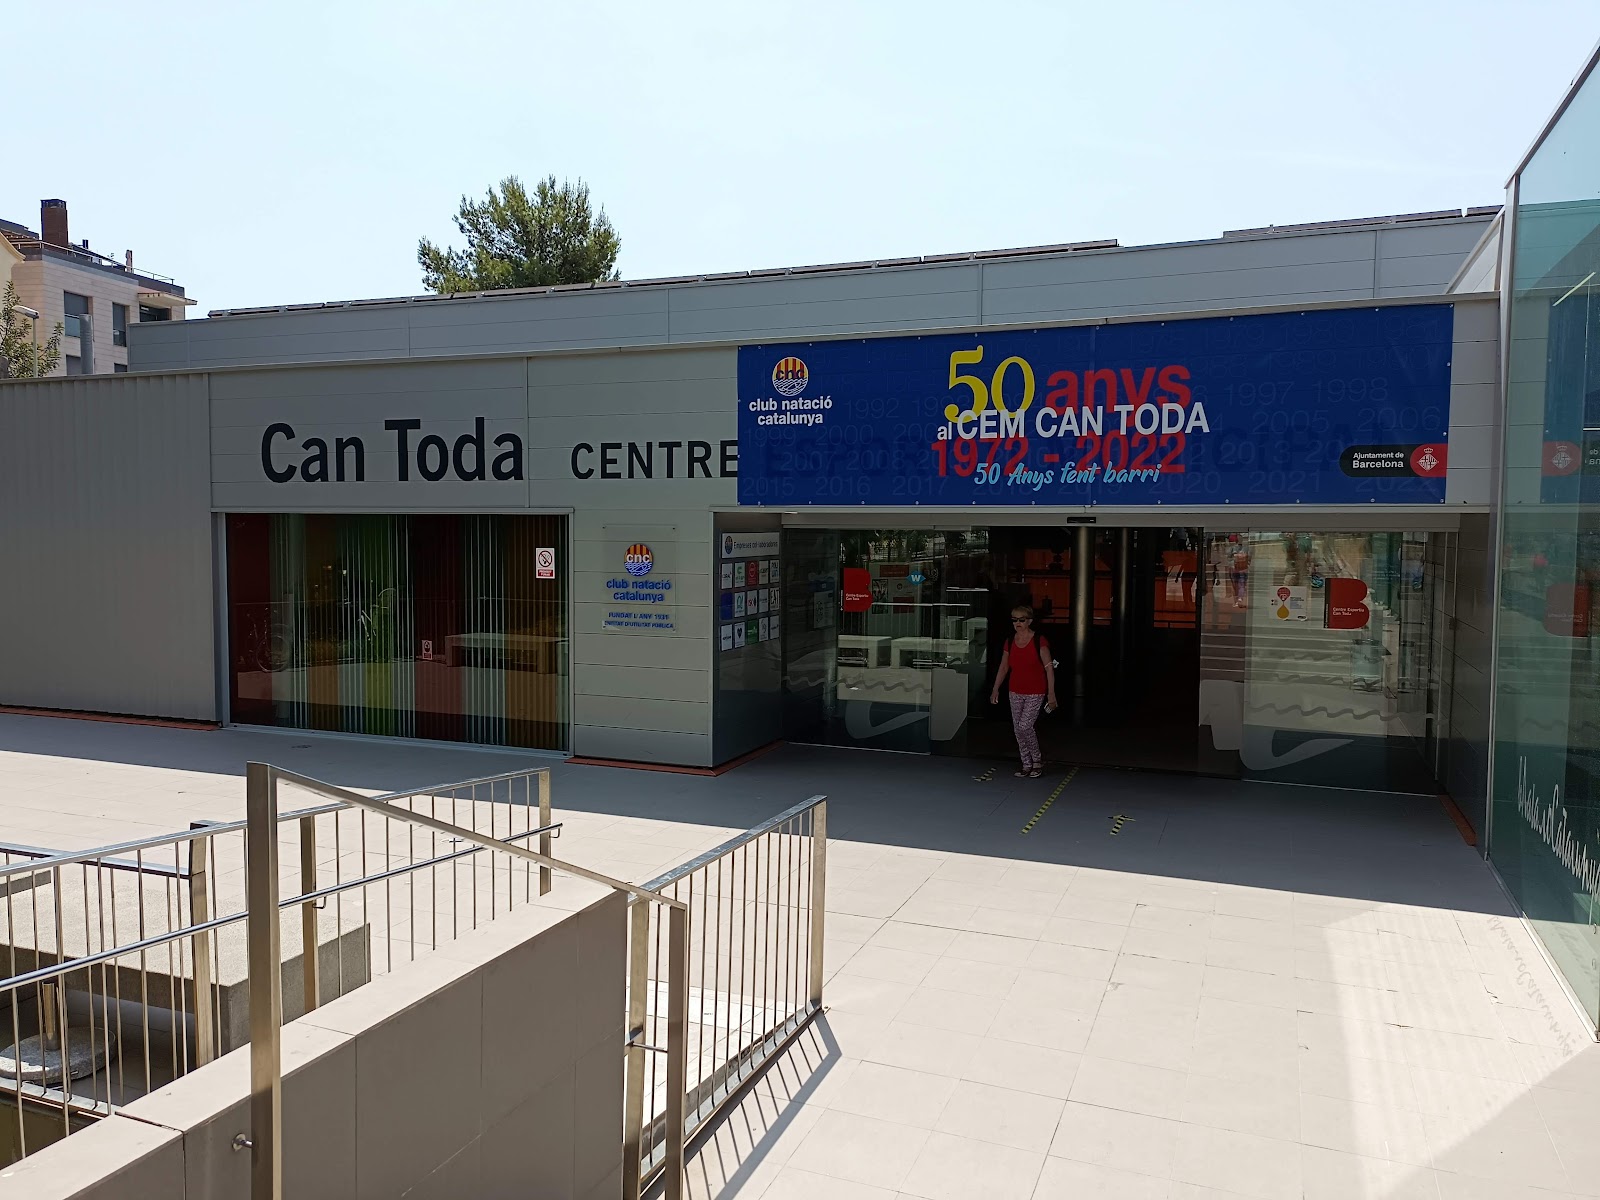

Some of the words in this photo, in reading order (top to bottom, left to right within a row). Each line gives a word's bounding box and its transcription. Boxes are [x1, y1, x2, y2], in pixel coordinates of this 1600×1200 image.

[944, 344, 1036, 424] 50
[1046, 365, 1192, 427] anys
[749, 398, 777, 411] club
[781, 396, 833, 410] natació
[757, 412, 824, 427] catalunya
[937, 422, 952, 440] al
[956, 410, 1026, 439] CEM
[1035, 406, 1104, 438] CAN
[1113, 402, 1210, 436] TODA
[260, 422, 364, 484] Can
[384, 417, 525, 482] Toda
[570, 440, 738, 480] CENTRE
[932, 437, 1029, 477] 1972
[1075, 431, 1186, 474] 2022
[1353, 452, 1394, 460] Ajuntament
[1352, 460, 1405, 469] Barcelona
[974, 463, 1001, 485] 50
[1008, 461, 1054, 491] Anys
[1061, 461, 1097, 484] fent
[1103, 461, 1162, 483] barri
[626, 553, 651, 563] cnc
[606, 578, 629, 589] club
[632, 577, 672, 591] natació
[614, 590, 665, 604] catalunya
